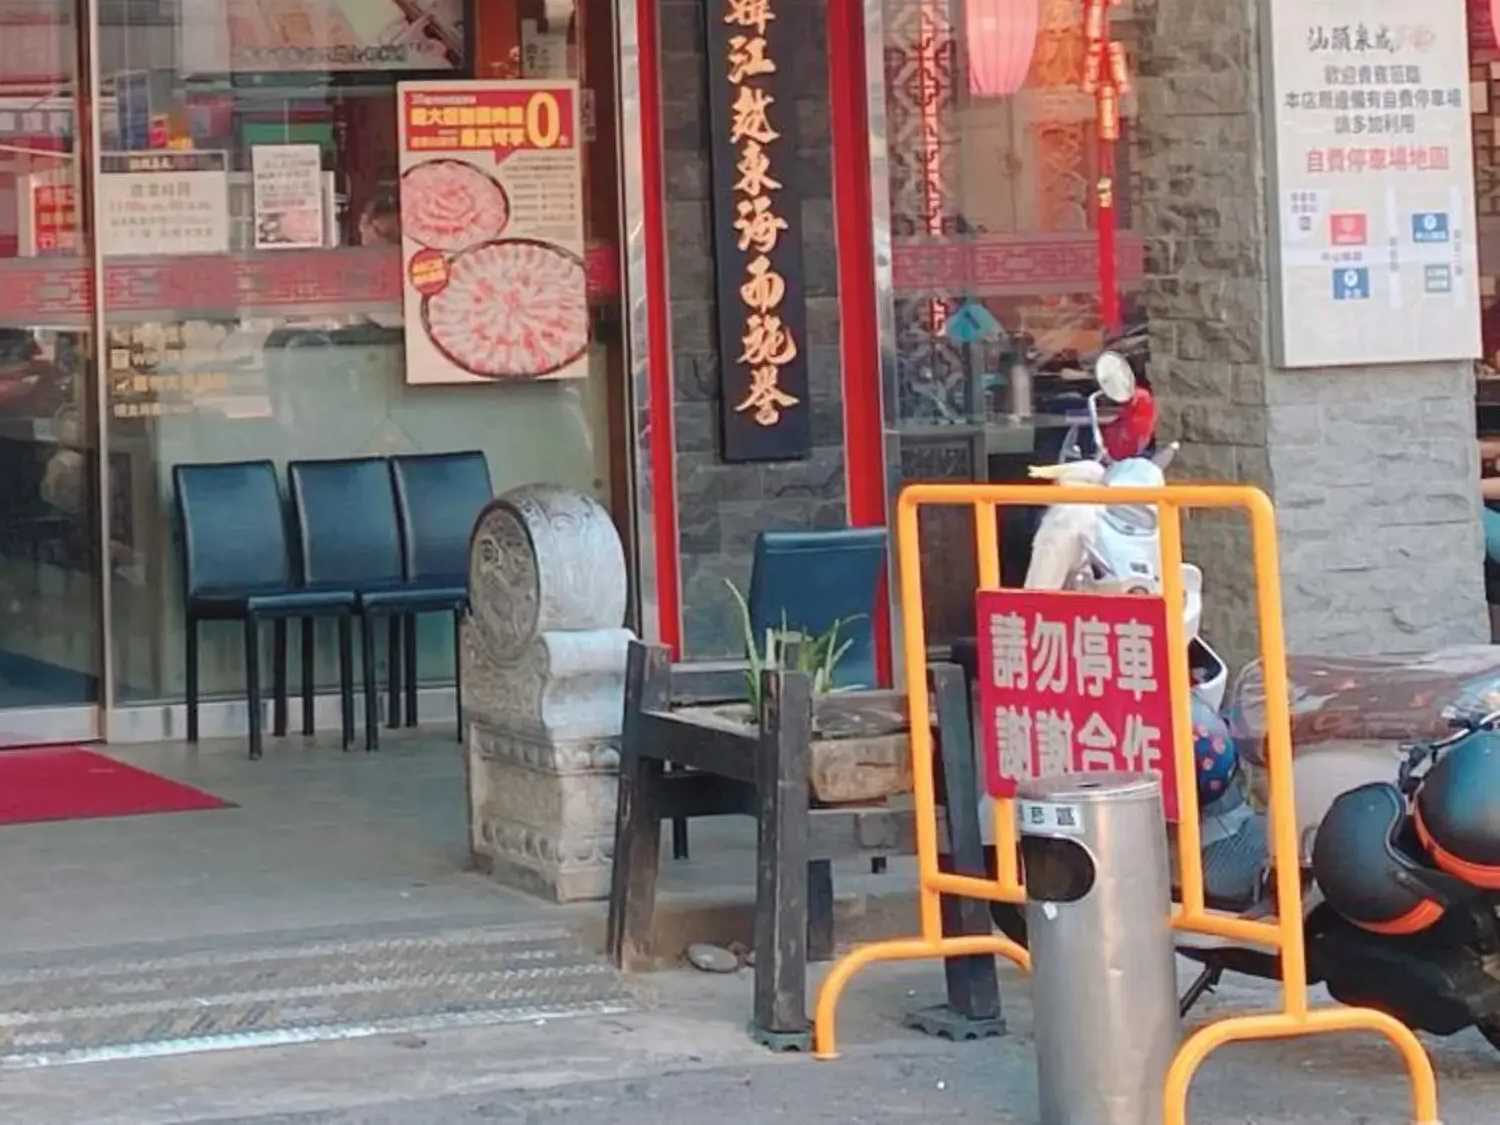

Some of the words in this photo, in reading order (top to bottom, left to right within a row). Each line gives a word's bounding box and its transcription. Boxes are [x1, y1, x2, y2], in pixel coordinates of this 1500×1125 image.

[989, 611, 1159, 702] 請勿停車
[995, 704, 1164, 781] 謝謝合作
